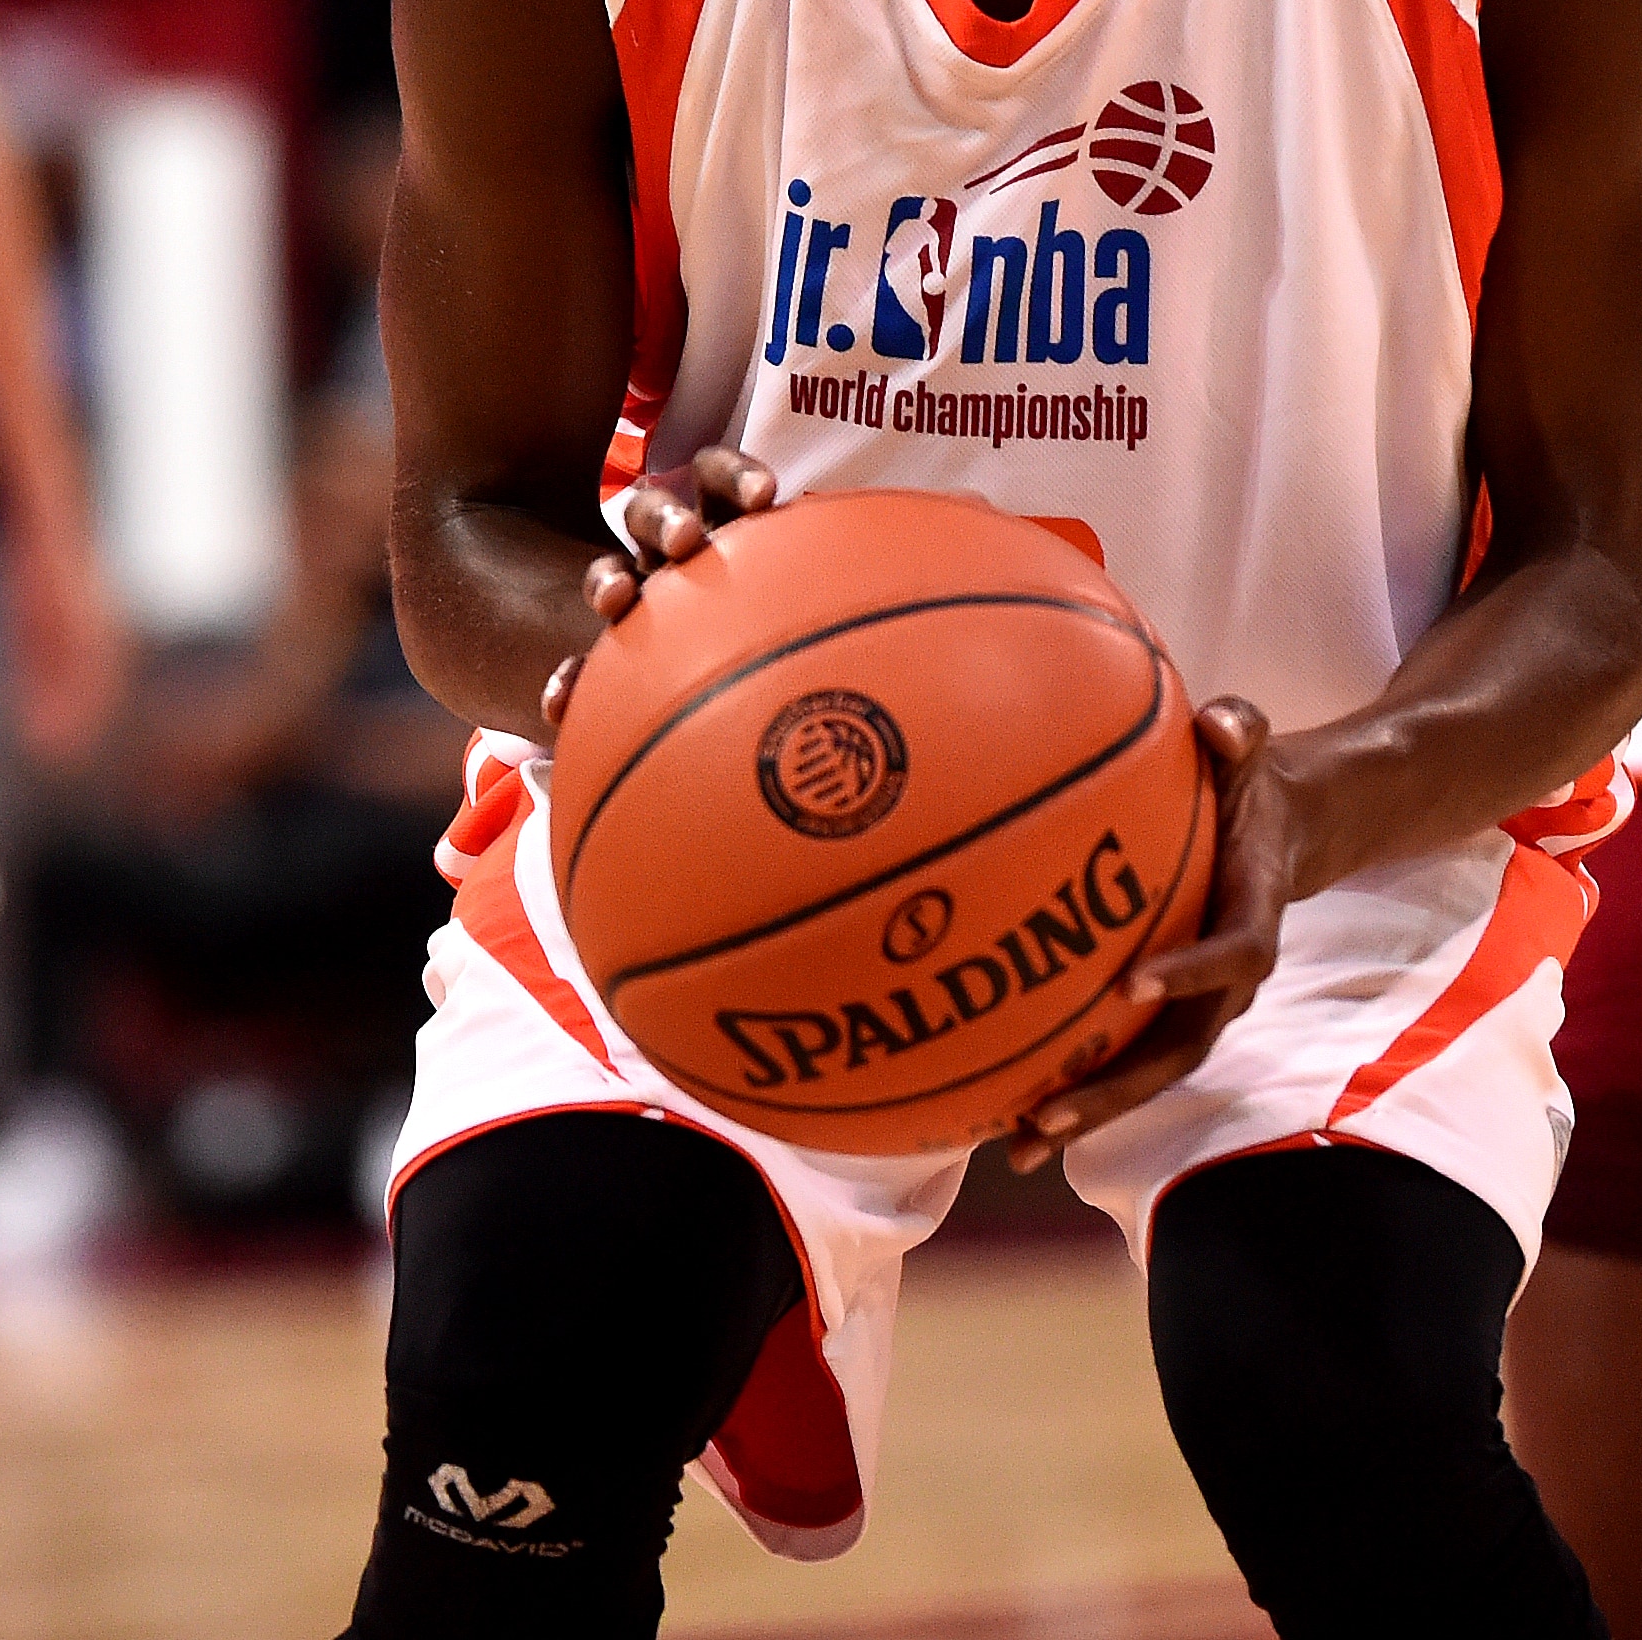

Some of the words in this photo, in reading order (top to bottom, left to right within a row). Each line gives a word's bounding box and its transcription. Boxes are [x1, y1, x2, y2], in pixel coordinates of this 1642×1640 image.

[764, 177, 856, 367] jr.
[959, 198, 1151, 366] nba
[789, 369, 887, 430] world
[892, 380, 1150, 451] championship
[715, 827, 1151, 1089] SPALDING
